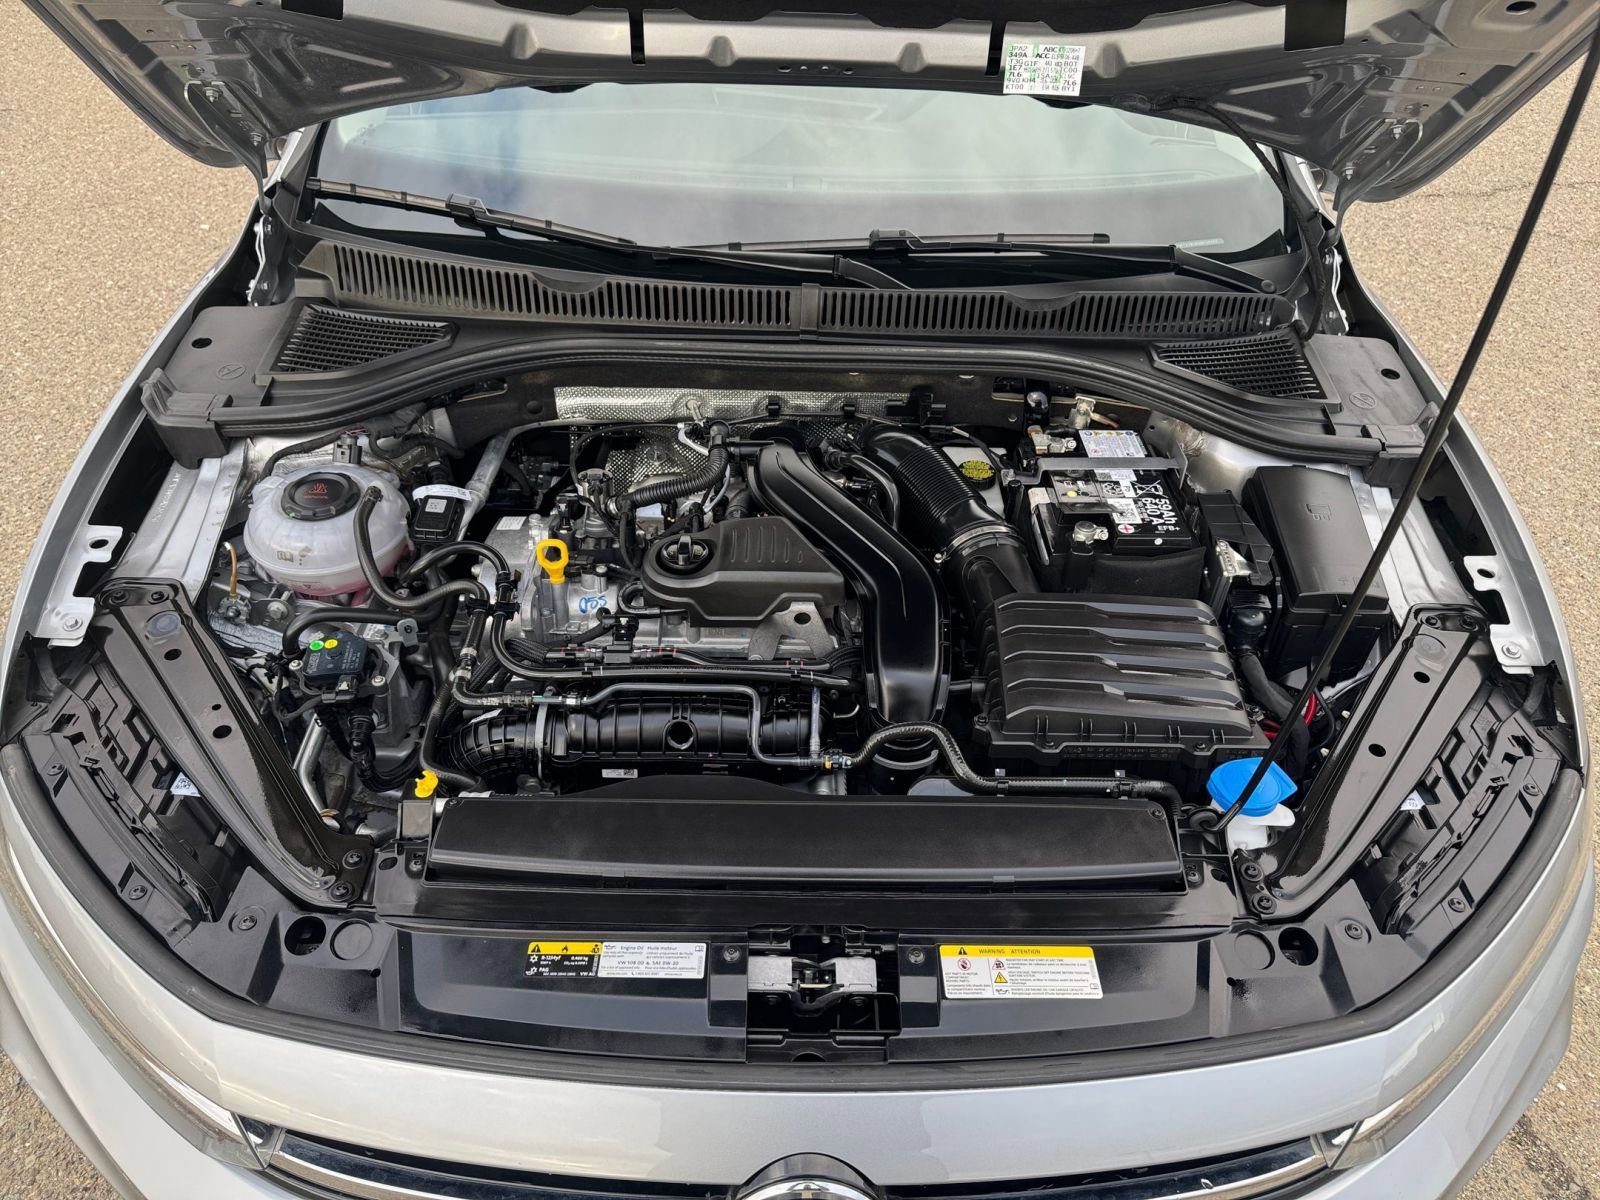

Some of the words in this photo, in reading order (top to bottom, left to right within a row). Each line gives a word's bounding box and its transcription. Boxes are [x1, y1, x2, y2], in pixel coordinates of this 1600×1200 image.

[1142, 498, 1160, 516] 640
[1156, 498, 1178, 524] 59Ah
[1150, 516, 1165, 524] A
